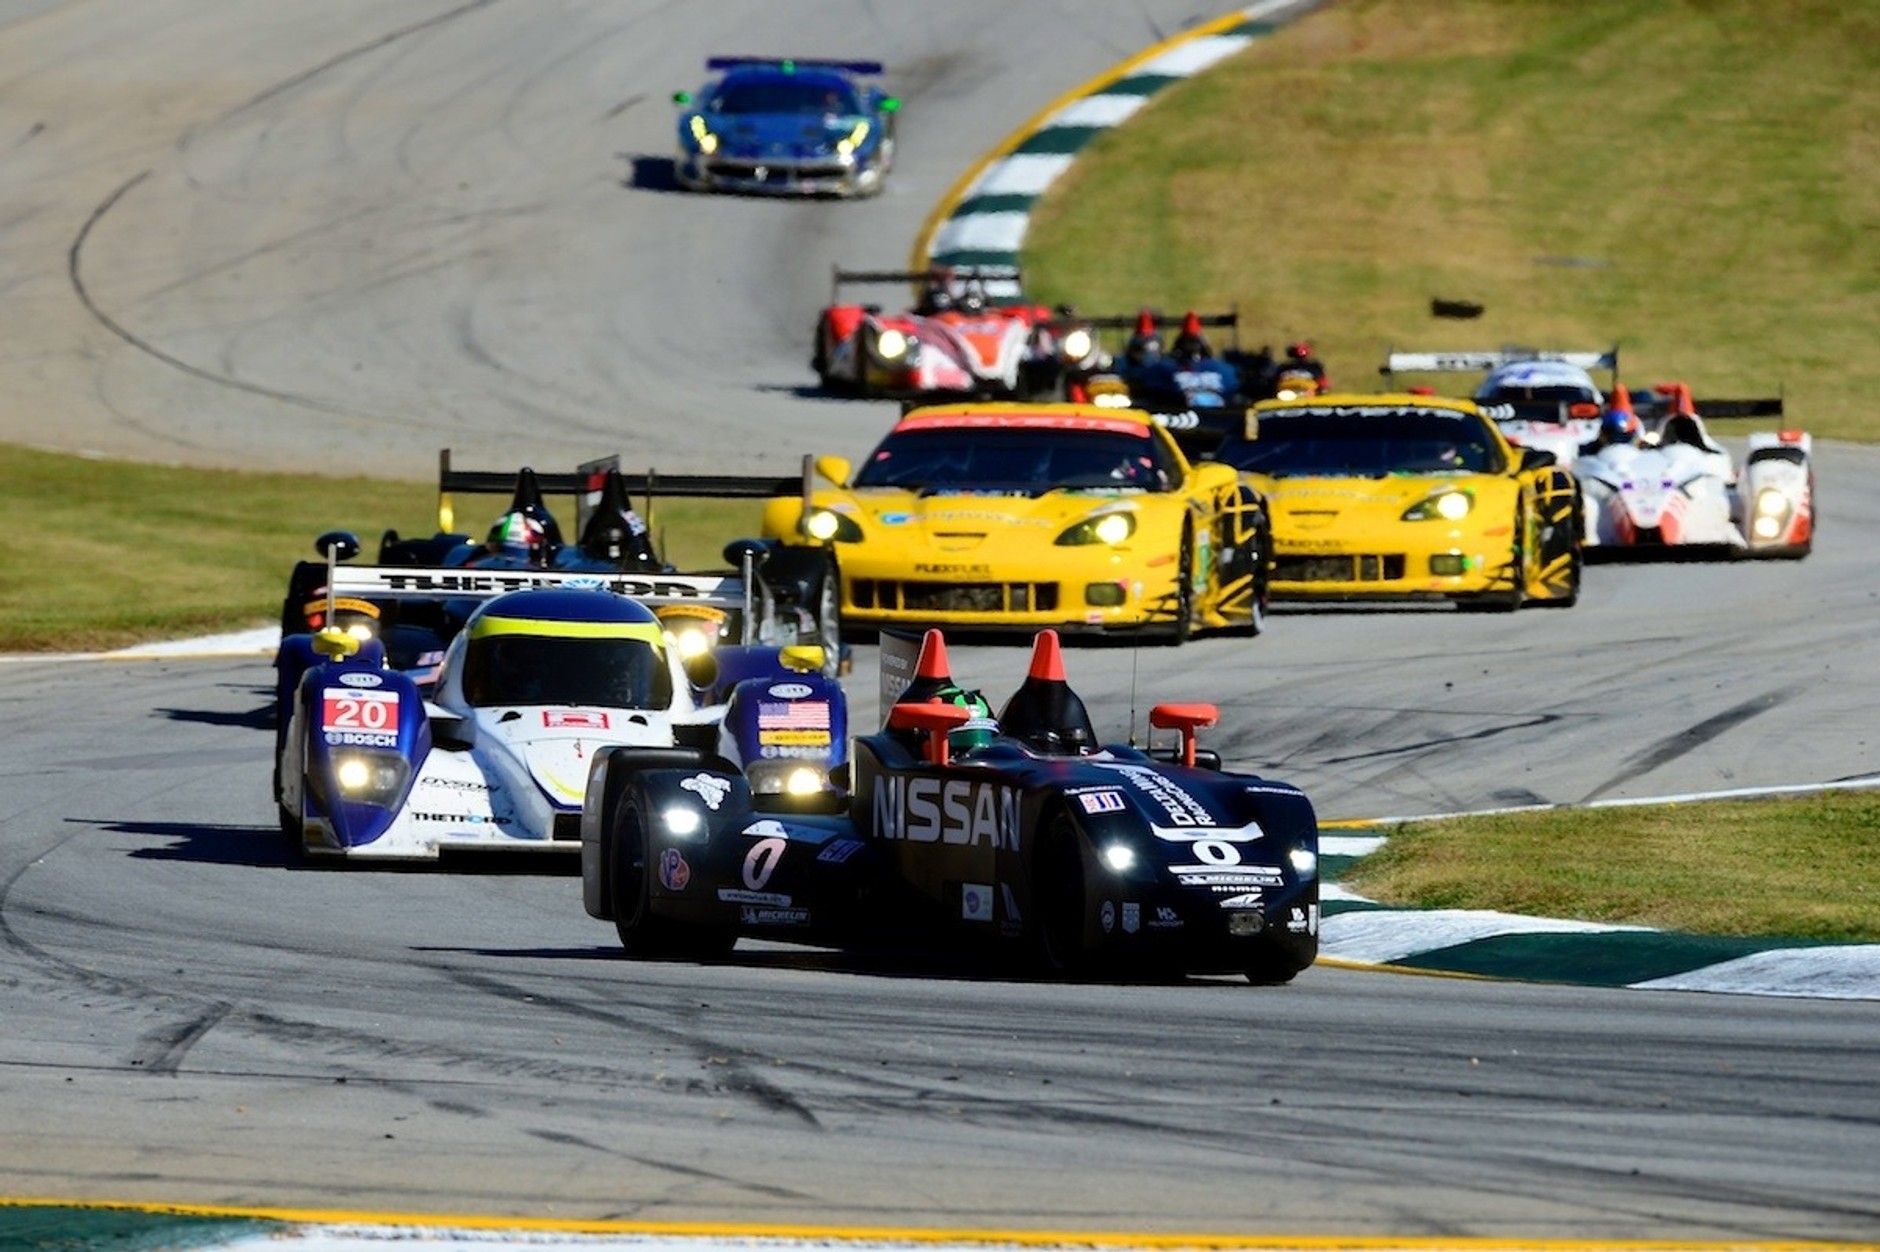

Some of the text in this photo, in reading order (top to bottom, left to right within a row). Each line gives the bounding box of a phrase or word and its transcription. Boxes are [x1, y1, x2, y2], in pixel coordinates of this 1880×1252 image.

[334, 700, 387, 728] 20
[343, 733, 397, 747] BOSCH
[411, 812, 512, 824] THETFORD
[873, 774, 1024, 852] NISSAN
[742, 837, 787, 890] 0
[1192, 840, 1241, 865] 0
[757, 909, 807, 921] MICHELIN
